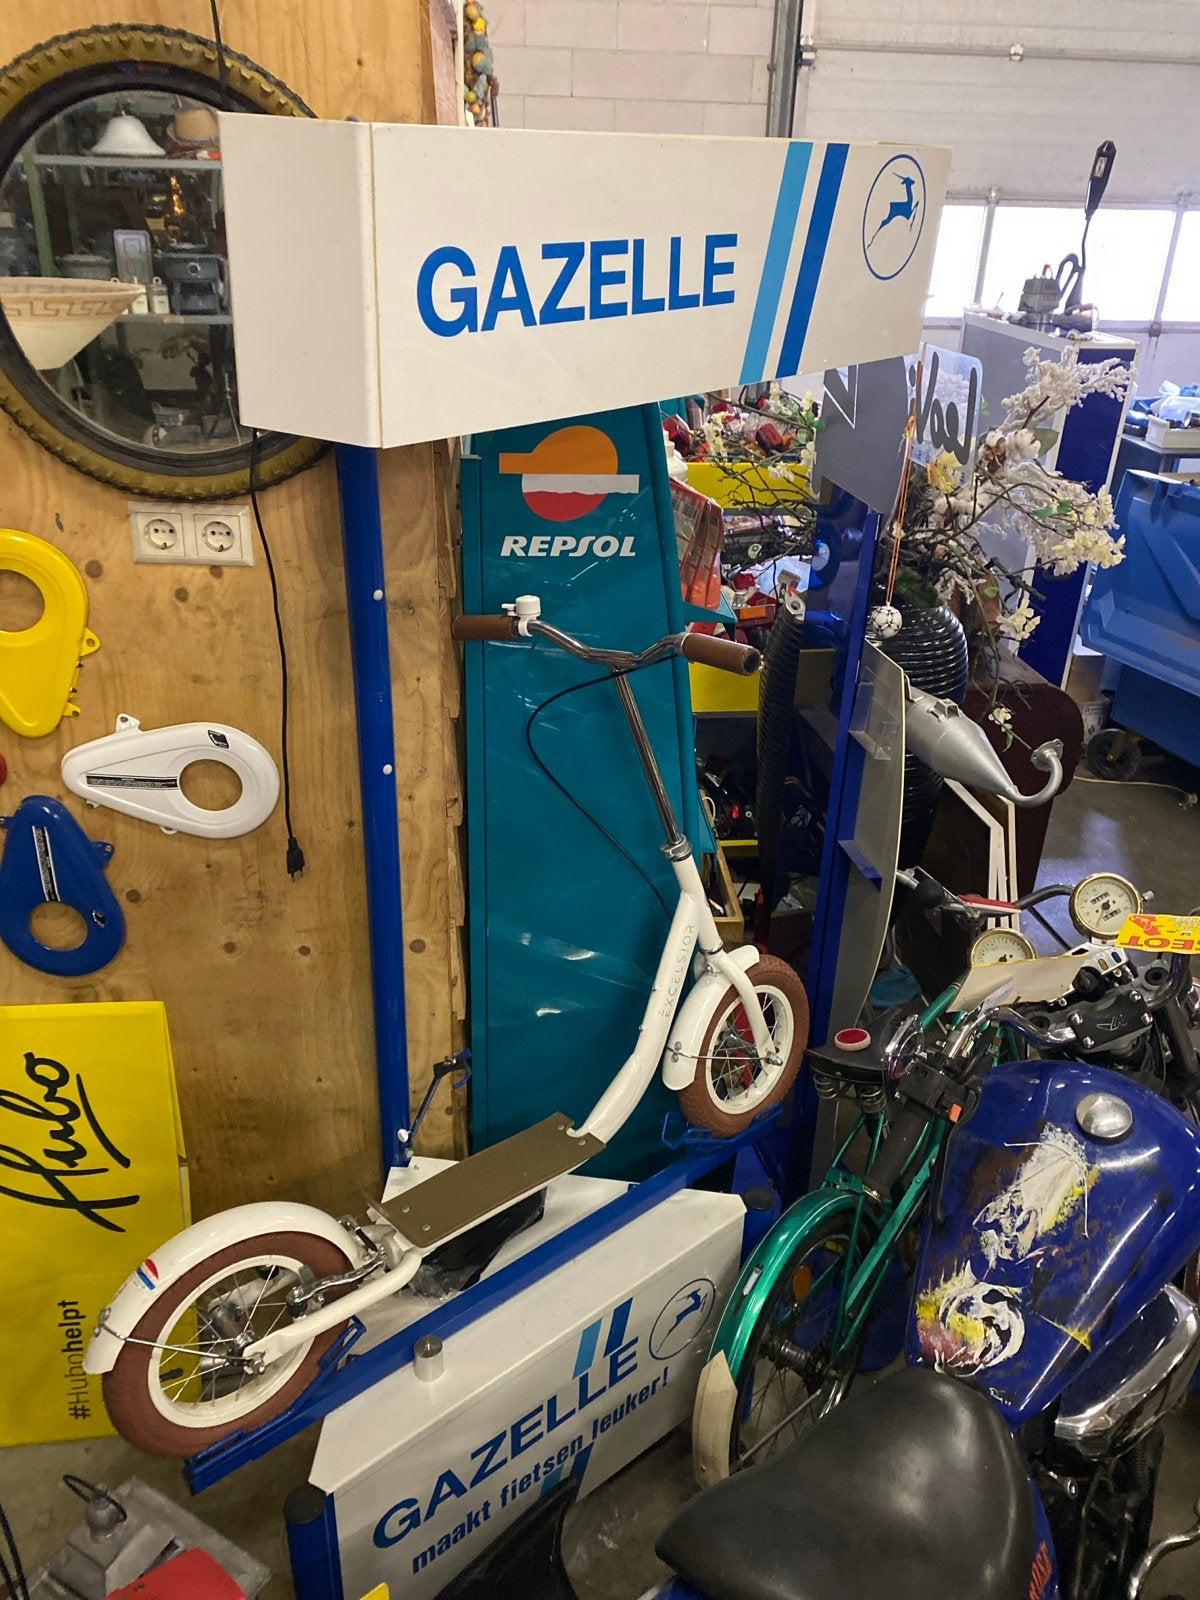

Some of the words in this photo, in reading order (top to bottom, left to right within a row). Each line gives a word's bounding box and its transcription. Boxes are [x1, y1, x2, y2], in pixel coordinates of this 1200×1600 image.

[416, 232, 738, 338] GAZELLE
[500, 535, 636, 558] REPSOL
[658, 925, 695, 1017] EXCELSIOR
[57, 1299, 91, 1420] #Hubohelpt
[372, 1335, 639, 1549] GAZELLE
[412, 1499, 492, 1575] maakt
[499, 1433, 584, 1509] fietsen
[591, 1366, 669, 1441] leuker!
